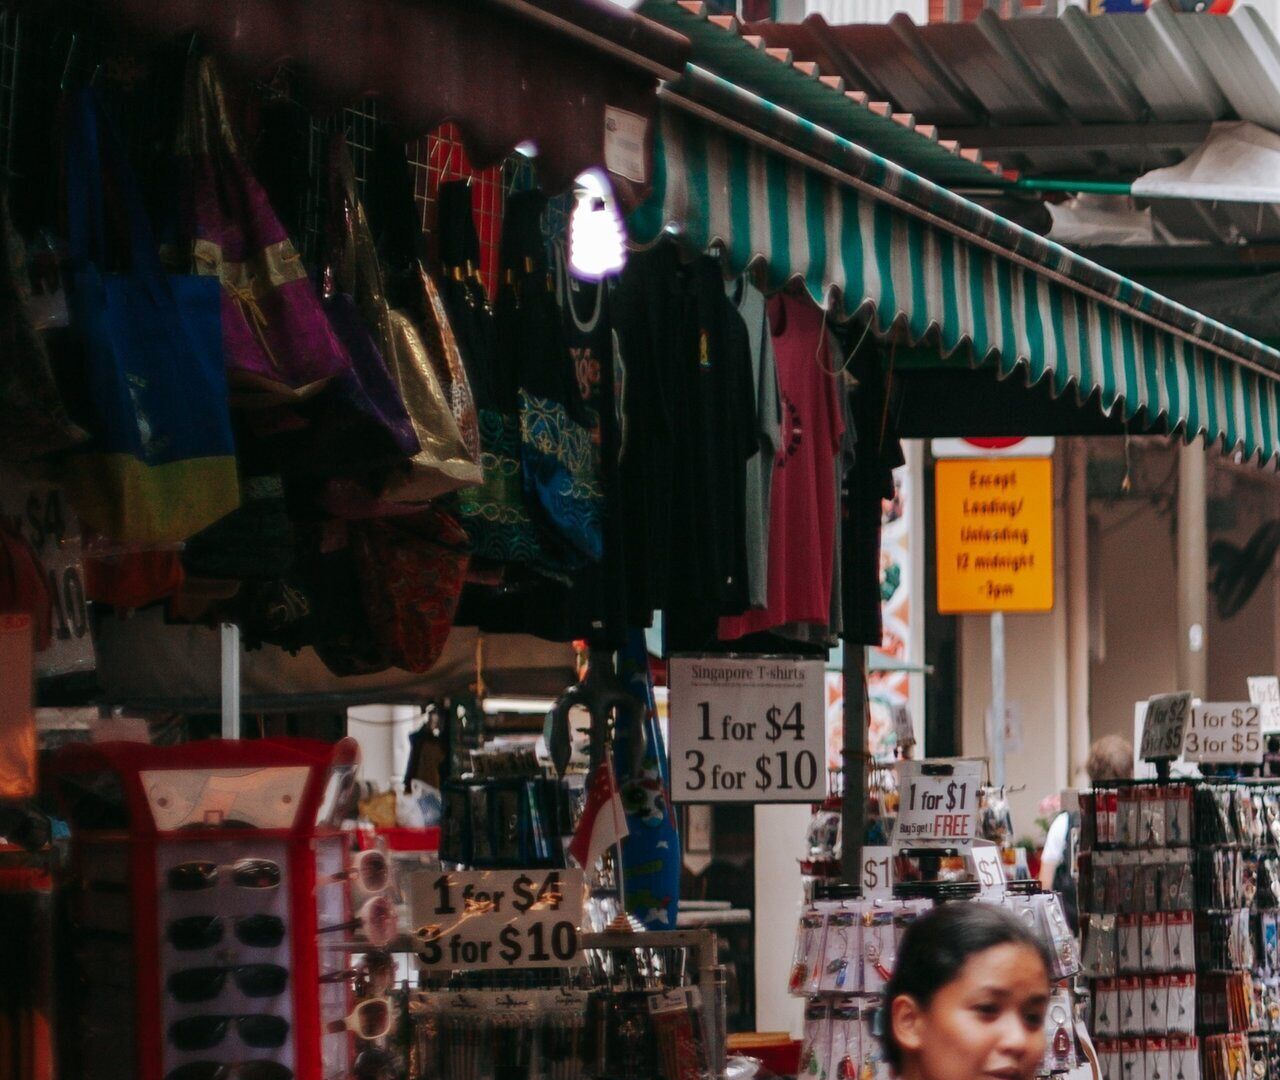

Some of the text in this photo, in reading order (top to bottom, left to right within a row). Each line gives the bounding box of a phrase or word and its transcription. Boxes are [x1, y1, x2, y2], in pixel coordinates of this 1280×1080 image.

[969, 470, 1017, 491] Except
[962, 497, 1024, 518] Loading/
[960, 526, 1029, 545] Unloading
[956, 553, 1034, 572] 12 midnight
[691, 665, 805, 682] Singapore T-shirts
[697, 701, 805, 744] 1 for $4
[1203, 712, 1226, 728] for
[1232, 707, 1258, 729] $2
[1186, 731, 1259, 754] 3 for $5
[685, 750, 817, 792] 3 for $10
[909, 780, 967, 812] 1 for $1
[900, 823, 912, 835] Buy
[917, 823, 928, 835] get
[934, 815, 971, 837] FREE
[864, 856, 889, 890] $1
[978, 856, 1004, 889] $1
[433, 872, 563, 915] 1 for $4
[450, 934, 492, 964] for
[499, 920, 577, 965] $10
